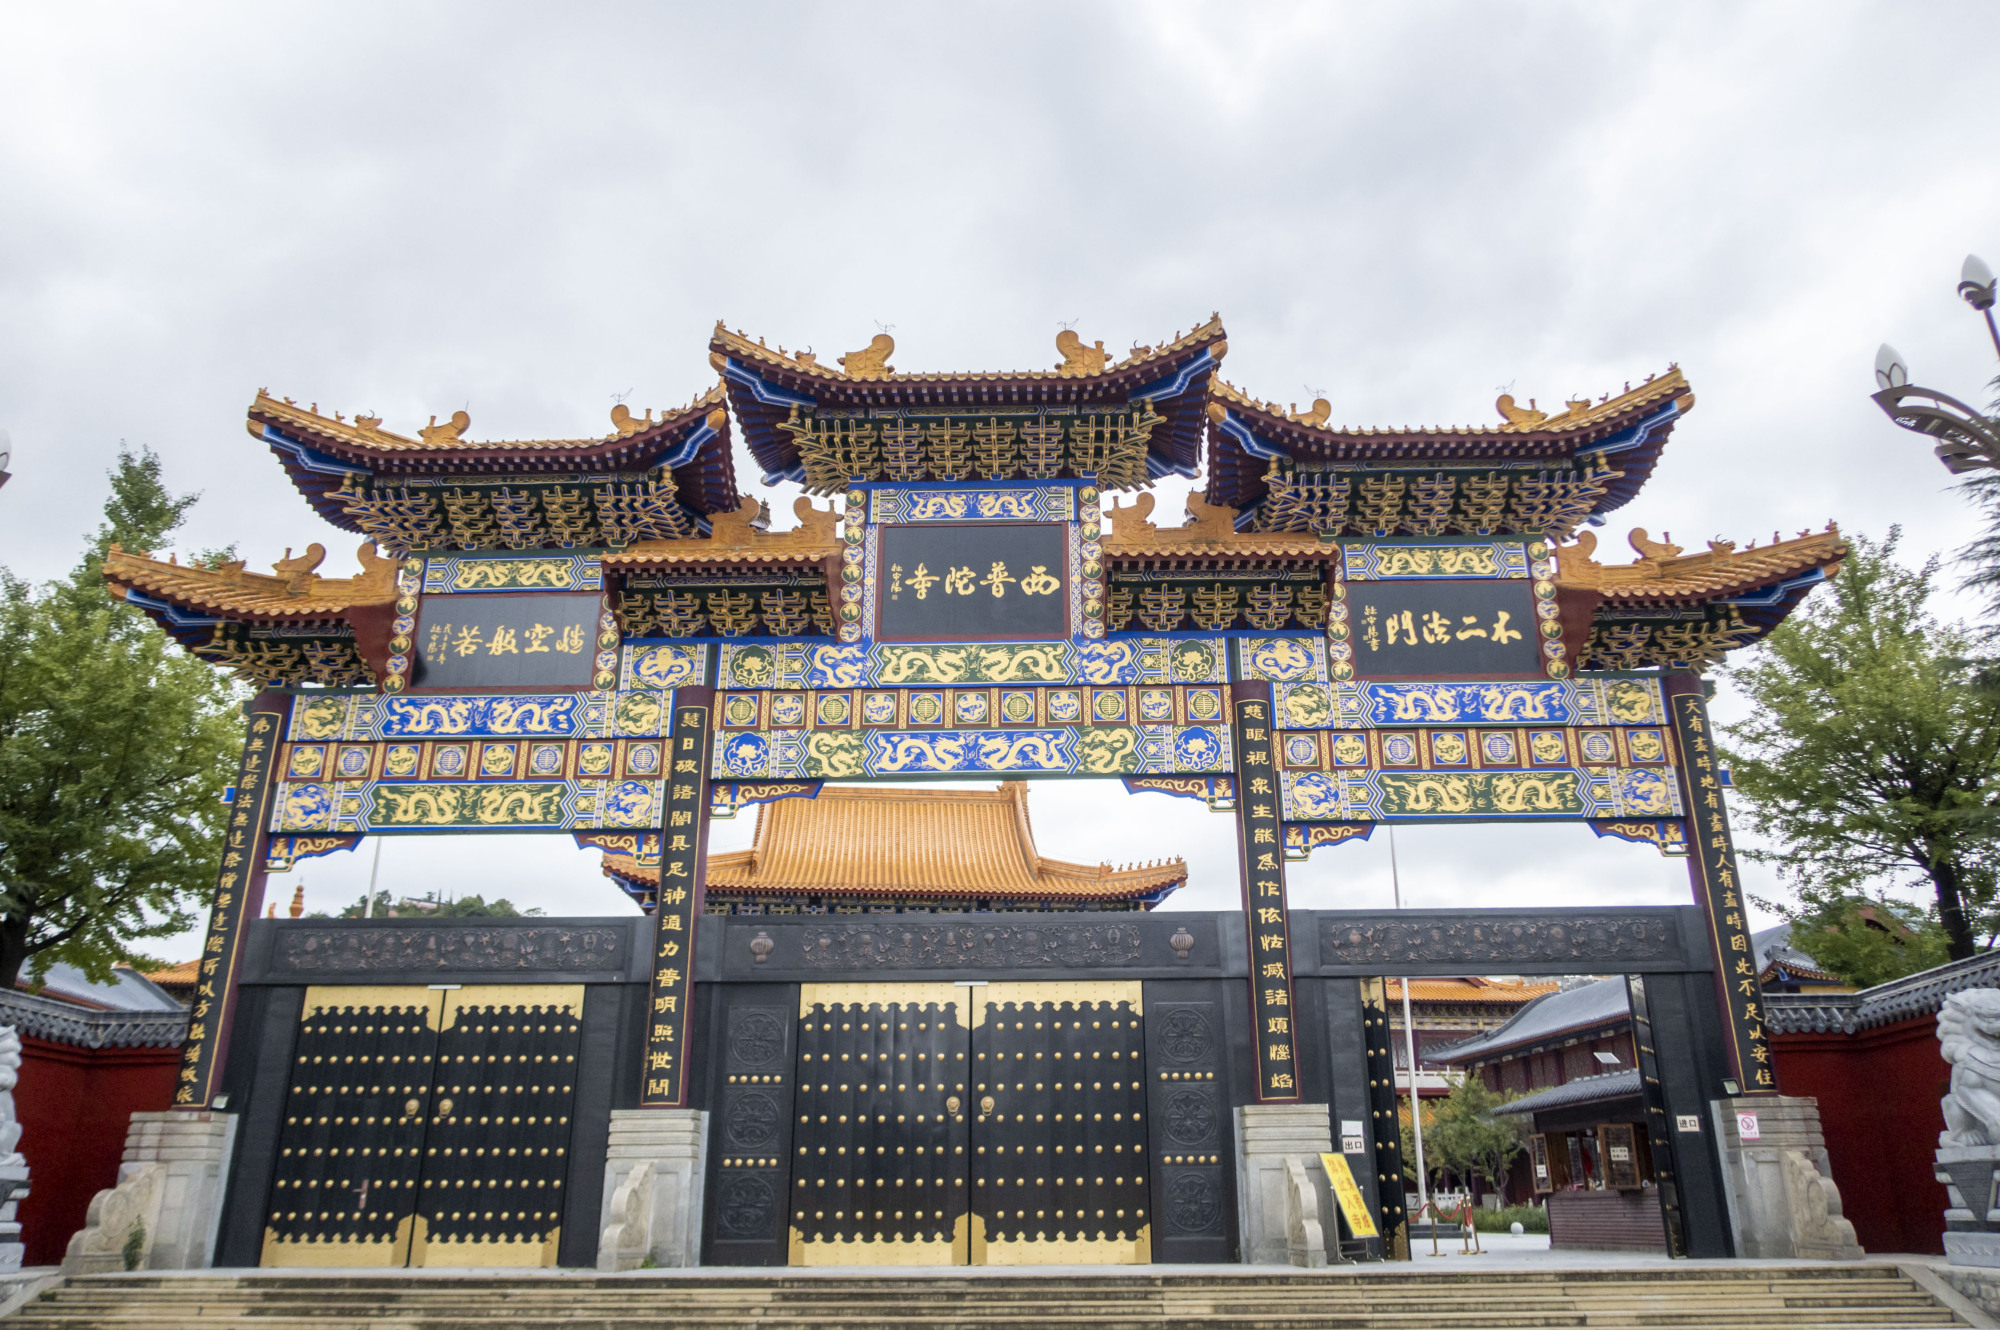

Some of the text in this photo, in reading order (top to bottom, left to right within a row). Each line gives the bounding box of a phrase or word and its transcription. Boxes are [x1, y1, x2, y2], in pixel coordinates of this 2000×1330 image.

[905, 561, 1061, 600] 西普陀寺
[451, 622, 586, 657] 性空般若
[1385, 609, 1523, 646] 不二法門
[1678, 1119, 1697, 1128] 进口
[1344, 1140, 1363, 1150] 出口
[1327, 1158, 1362, 1230] 禁止入寺
